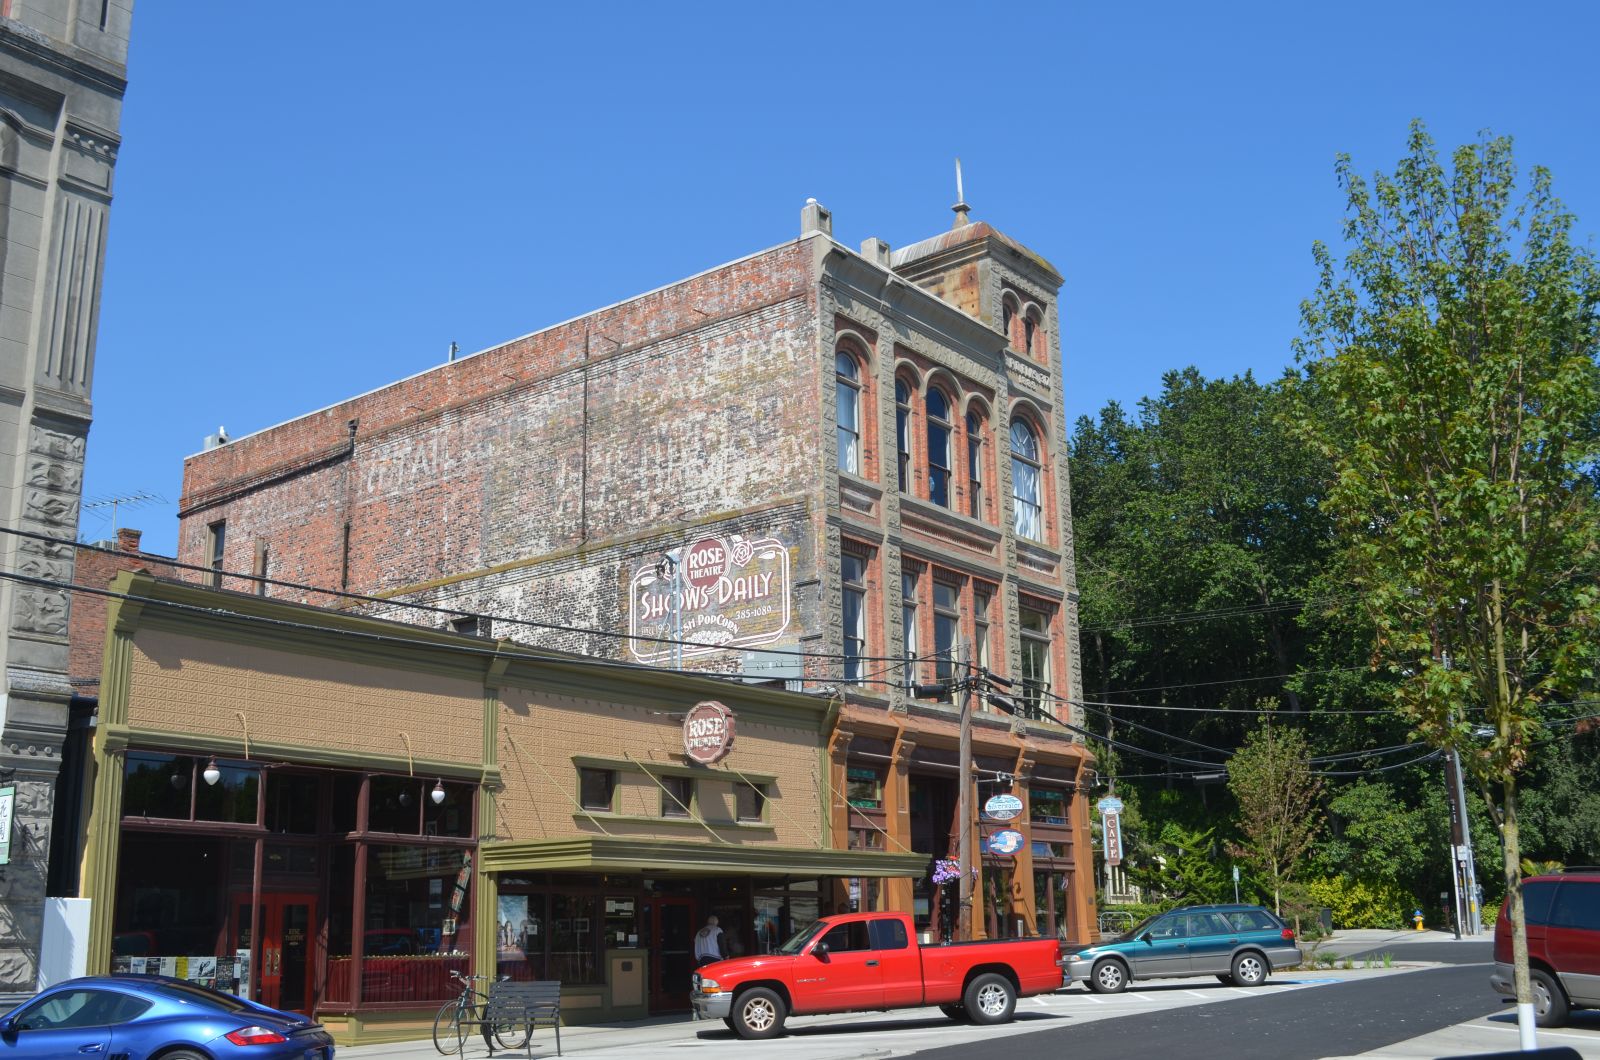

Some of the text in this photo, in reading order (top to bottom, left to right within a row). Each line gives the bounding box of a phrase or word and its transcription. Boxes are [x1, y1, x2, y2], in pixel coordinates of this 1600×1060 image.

[689, 547, 725, 569] ROSE
[690, 564, 724, 579] THEATRE
[718, 572, 773, 604] DAILY
[688, 717, 724, 737] ROSE
